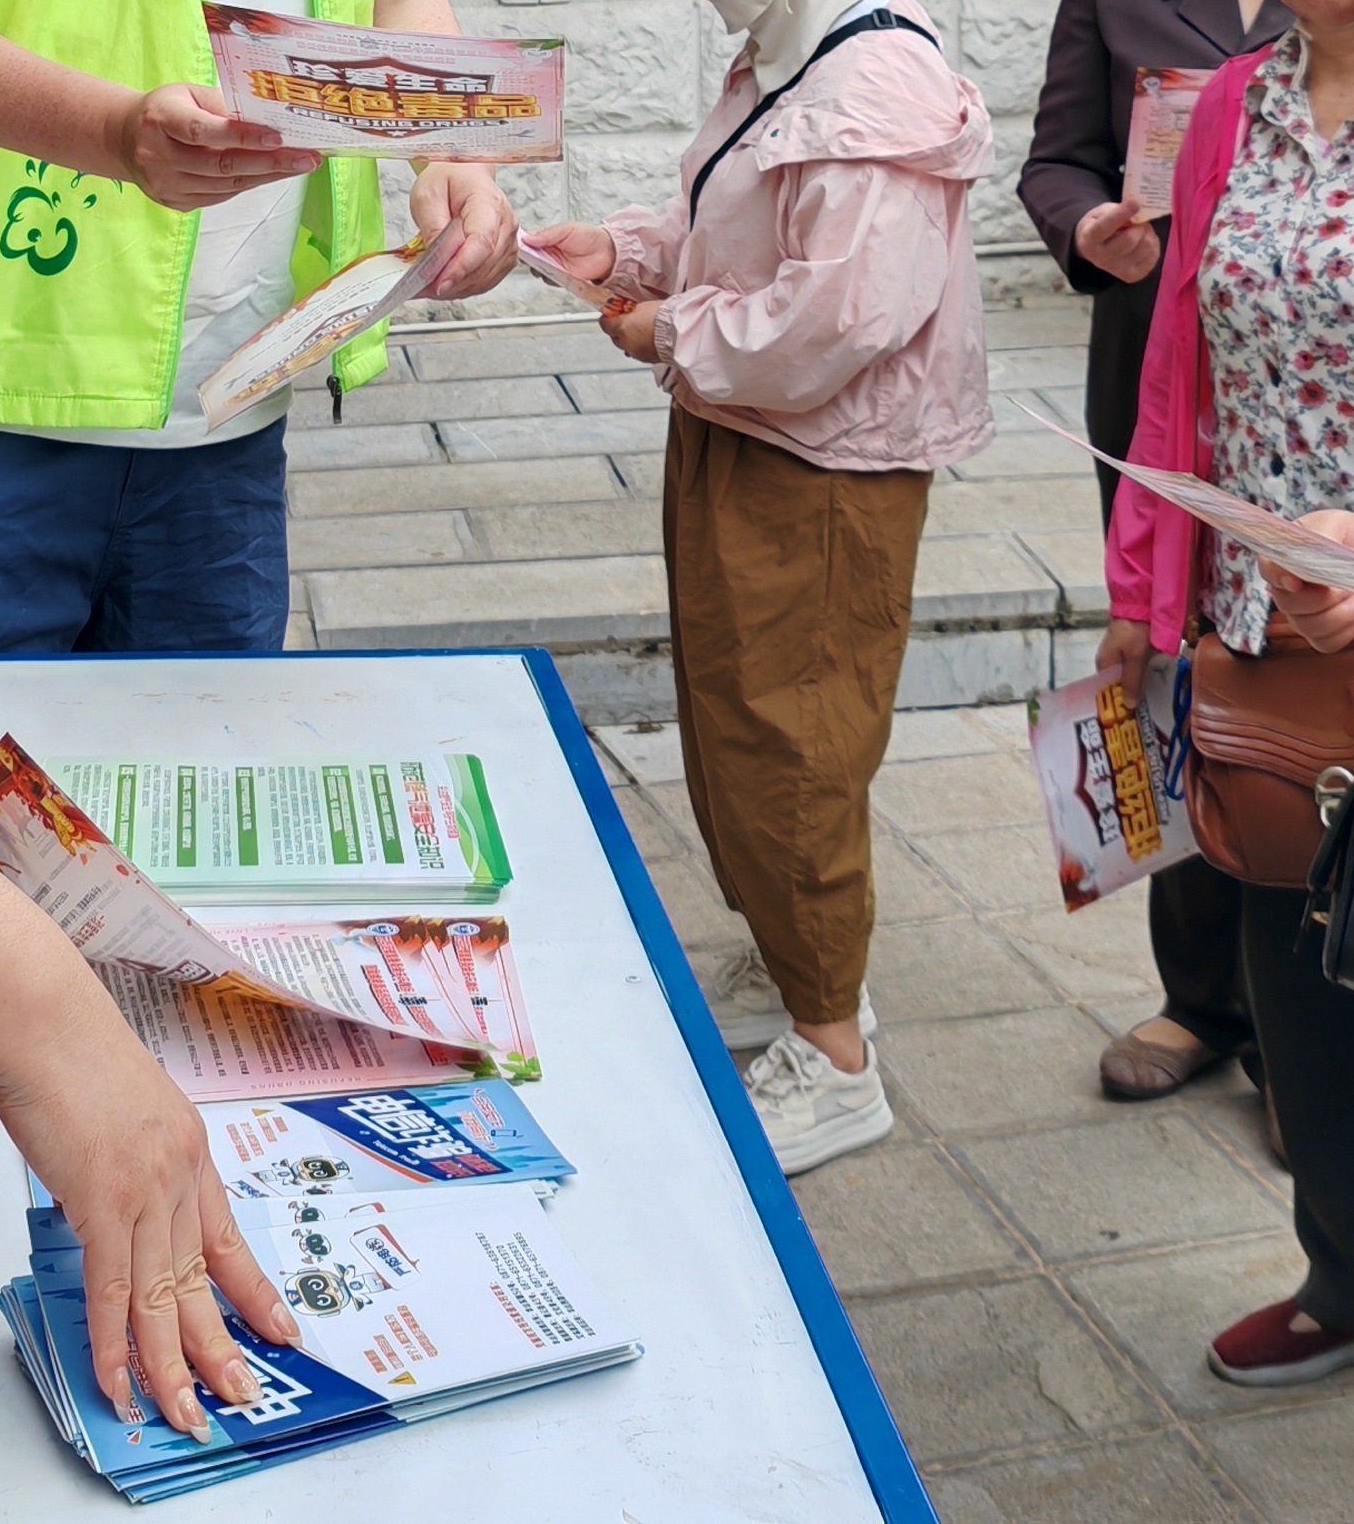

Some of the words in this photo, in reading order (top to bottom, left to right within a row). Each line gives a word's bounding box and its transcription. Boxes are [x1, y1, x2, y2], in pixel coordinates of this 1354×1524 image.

[243, 69, 541, 118] 拒绝毒品
[292, 60, 488, 93] 珍爱生命
[292, 107, 412, 128] REFUSING
[414, 119, 503, 128] DRUGS
[1079, 719, 1120, 842] 珍爱生命
